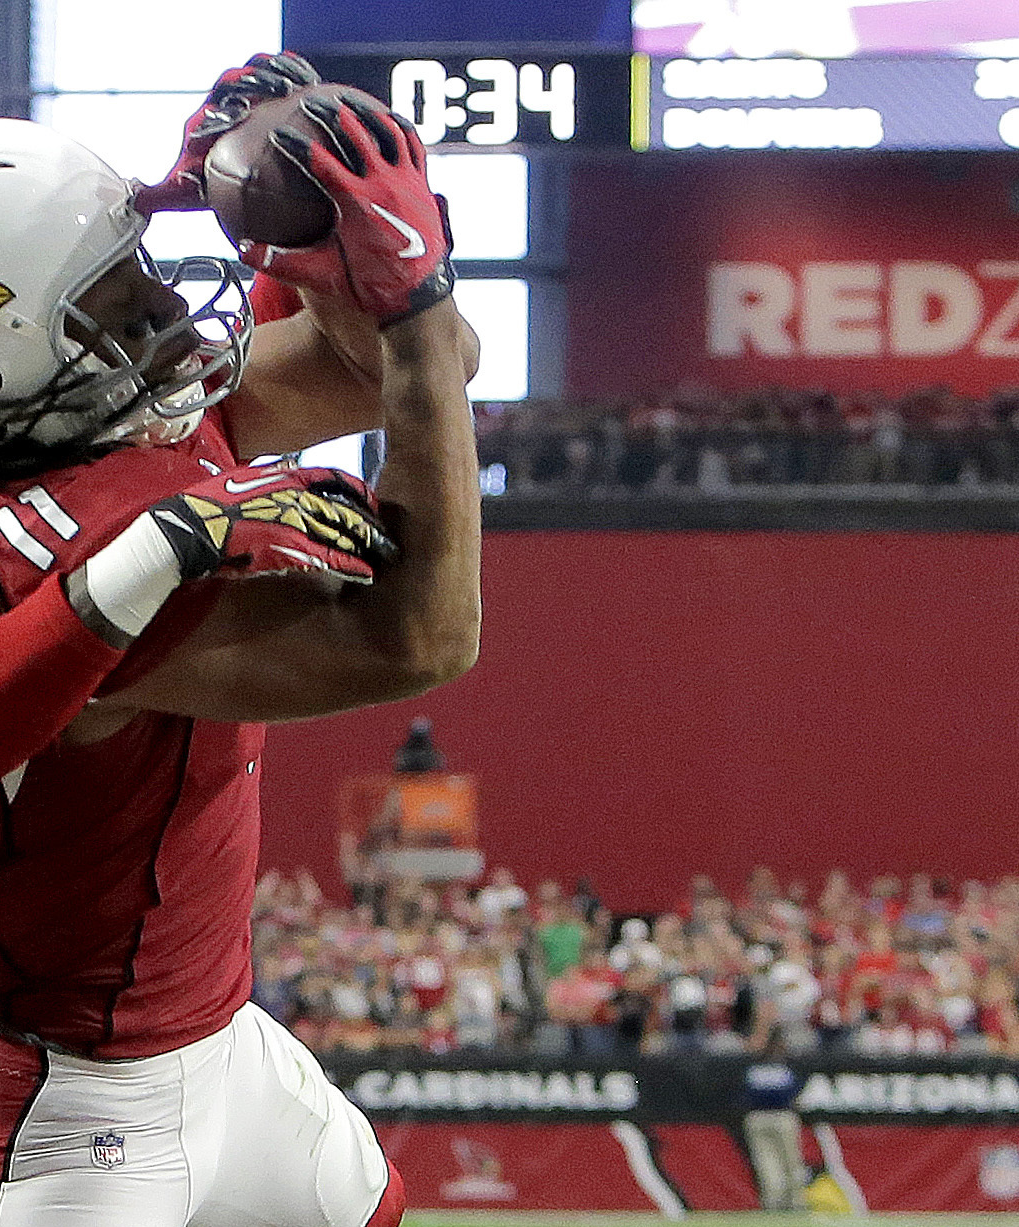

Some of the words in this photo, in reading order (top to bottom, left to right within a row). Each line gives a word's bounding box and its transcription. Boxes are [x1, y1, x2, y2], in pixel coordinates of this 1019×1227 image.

[391, 58, 577, 146] 0:34
[352, 1070, 639, 1110] CARDINALS
[796, 1072, 1019, 1113] ARIZONA
